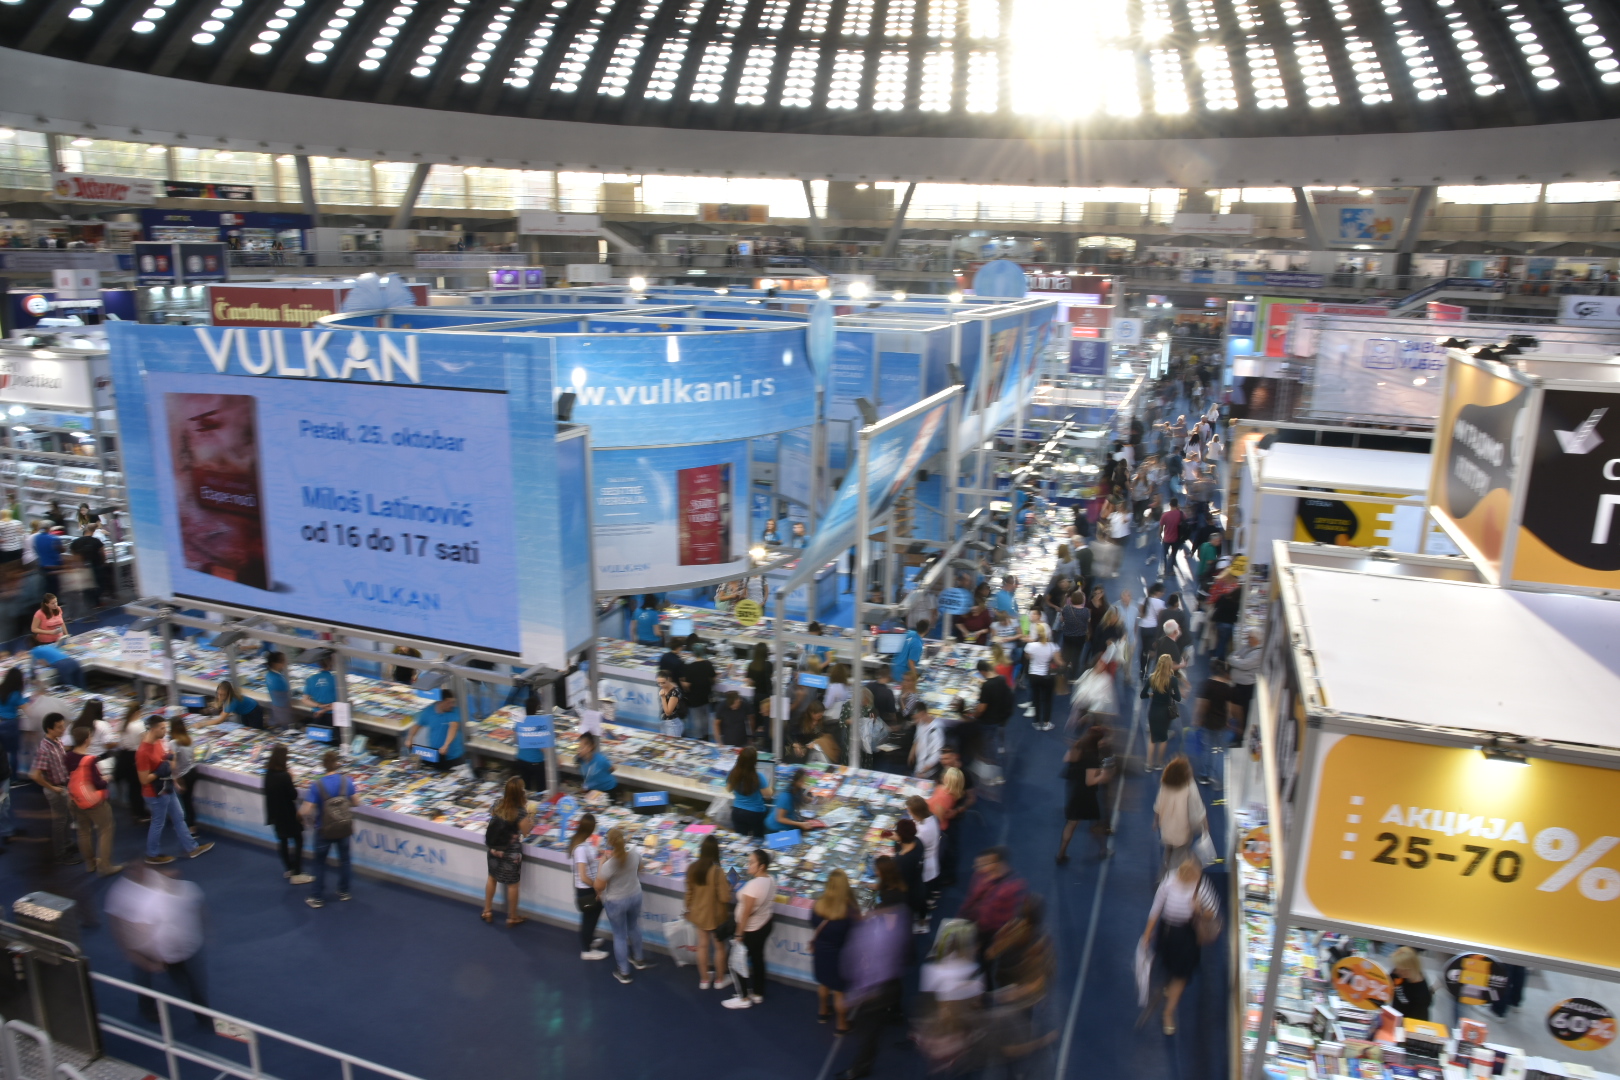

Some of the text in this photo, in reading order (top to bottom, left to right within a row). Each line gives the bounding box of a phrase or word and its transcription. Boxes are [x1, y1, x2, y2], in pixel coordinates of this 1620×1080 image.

[196, 327, 420, 383] VULKAN
[358, 425, 387, 444] 25.
[391, 428, 466, 451] oktobar
[302, 486, 472, 527] Miloš Latinović
[301, 521, 480, 564] od 16 do 17 sati
[344, 579, 441, 609] VULKAN
[1379, 804, 1529, 844] АКЦИЈА
[1337, 968, 1390, 1001] 70%
[1551, 1012, 1616, 1039] 60%
